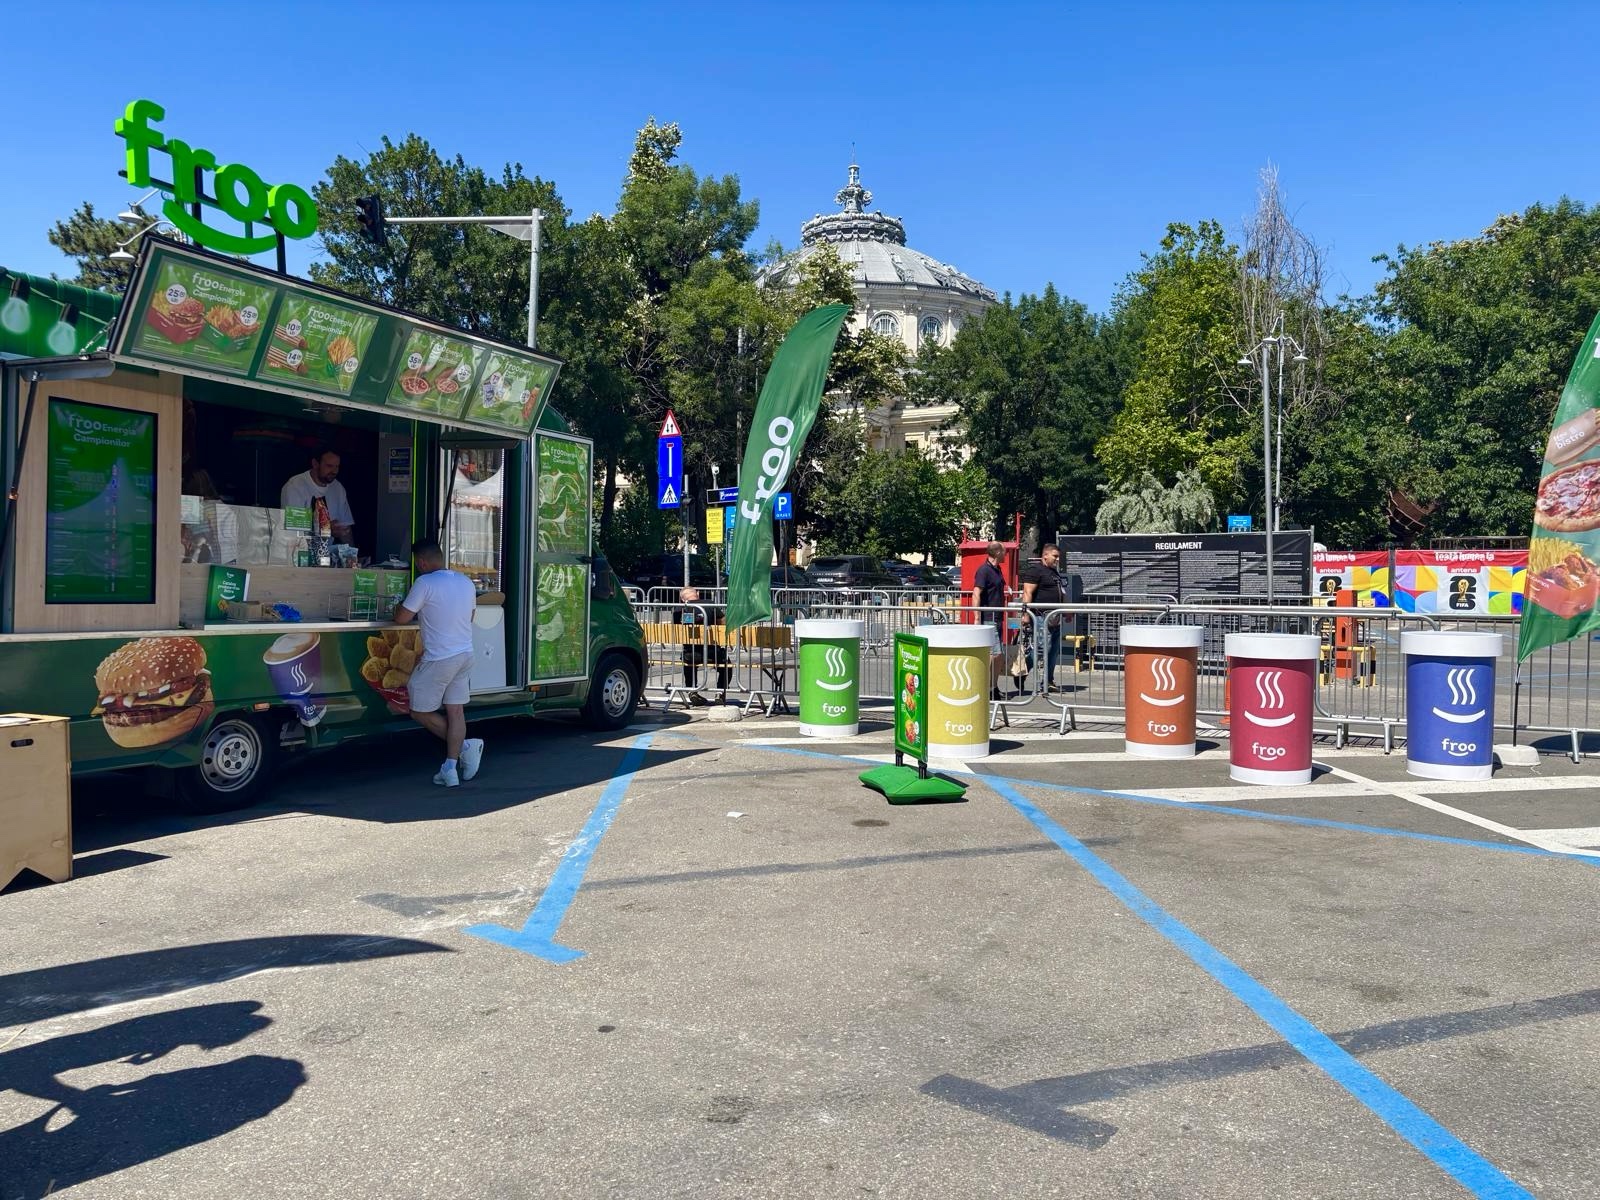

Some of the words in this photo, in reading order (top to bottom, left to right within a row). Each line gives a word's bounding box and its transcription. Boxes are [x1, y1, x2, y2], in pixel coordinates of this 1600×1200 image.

[115, 99, 318, 240] froo
[192, 272, 220, 289] froo
[742, 416, 794, 524] froo
[1155, 542, 1203, 550] REGULAMENT
[823, 702, 847, 713] froo
[945, 720, 973, 733] froo
[1147, 720, 1177, 733] froo
[1252, 742, 1286, 757] froo
[1441, 738, 1477, 752] froo
